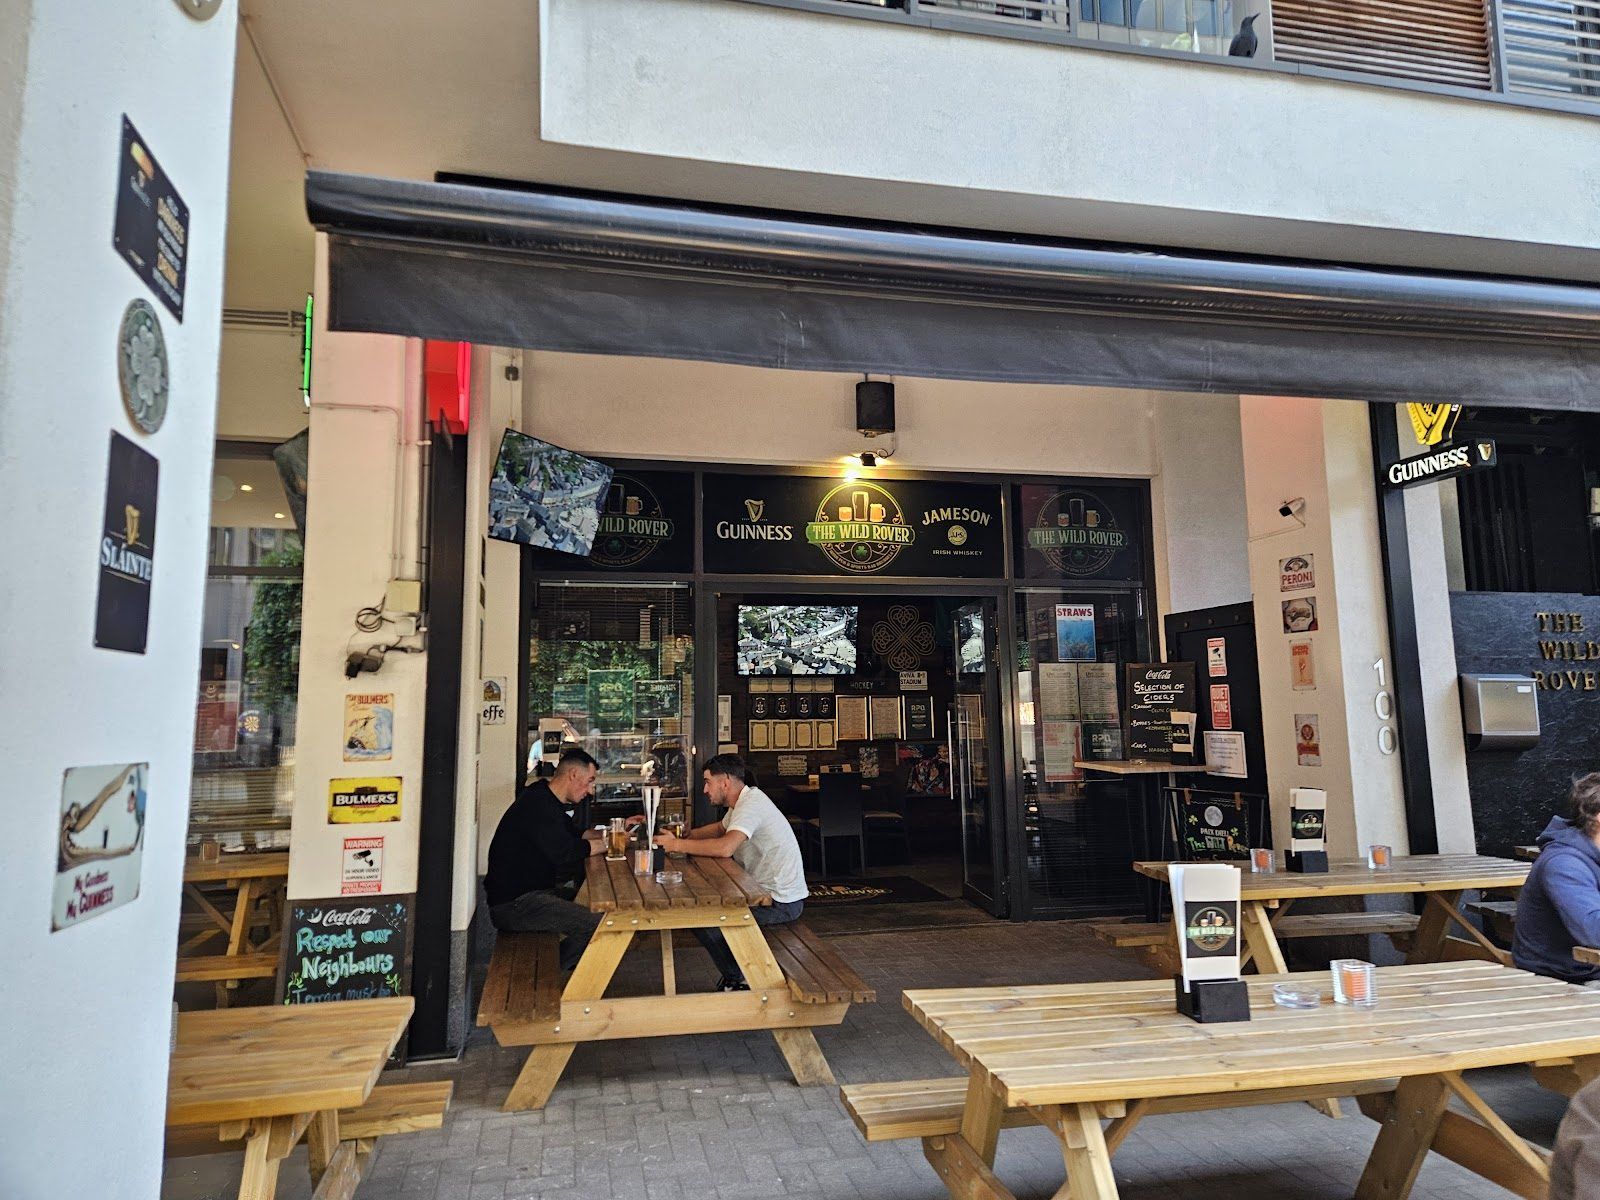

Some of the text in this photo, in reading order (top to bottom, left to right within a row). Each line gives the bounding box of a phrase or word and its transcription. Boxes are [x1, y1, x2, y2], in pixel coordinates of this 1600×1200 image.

[1388, 446, 1470, 485] GUINNESS
[922, 507, 991, 526] JAMESON
[628, 518, 669, 537] ROVER
[716, 520, 793, 541] GUINNESS
[812, 524, 910, 543] THE WILD ROVER
[1034, 529, 1123, 546] THE WILD ROVER
[100, 536, 153, 581] SLÁINTE
[1281, 571, 1313, 586] PERONI
[1056, 607, 1093, 617] STRAWS
[1534, 611, 1585, 632] THE
[1537, 640, 1600, 660] WILD
[850, 682, 874, 690] HOCKEY
[1133, 681, 1172, 692] SELECTION
[1531, 669, 1600, 692] ROVE
[357, 694, 389, 705] BULMERS
[1143, 693, 1175, 702] CIDERS
[335, 793, 396, 805] BULMERS
[344, 839, 382, 849] WARNING
[80, 884, 114, 915] GUINNESS
[296, 927, 392, 956] Respect our
[301, 951, 394, 988] Neighbours
